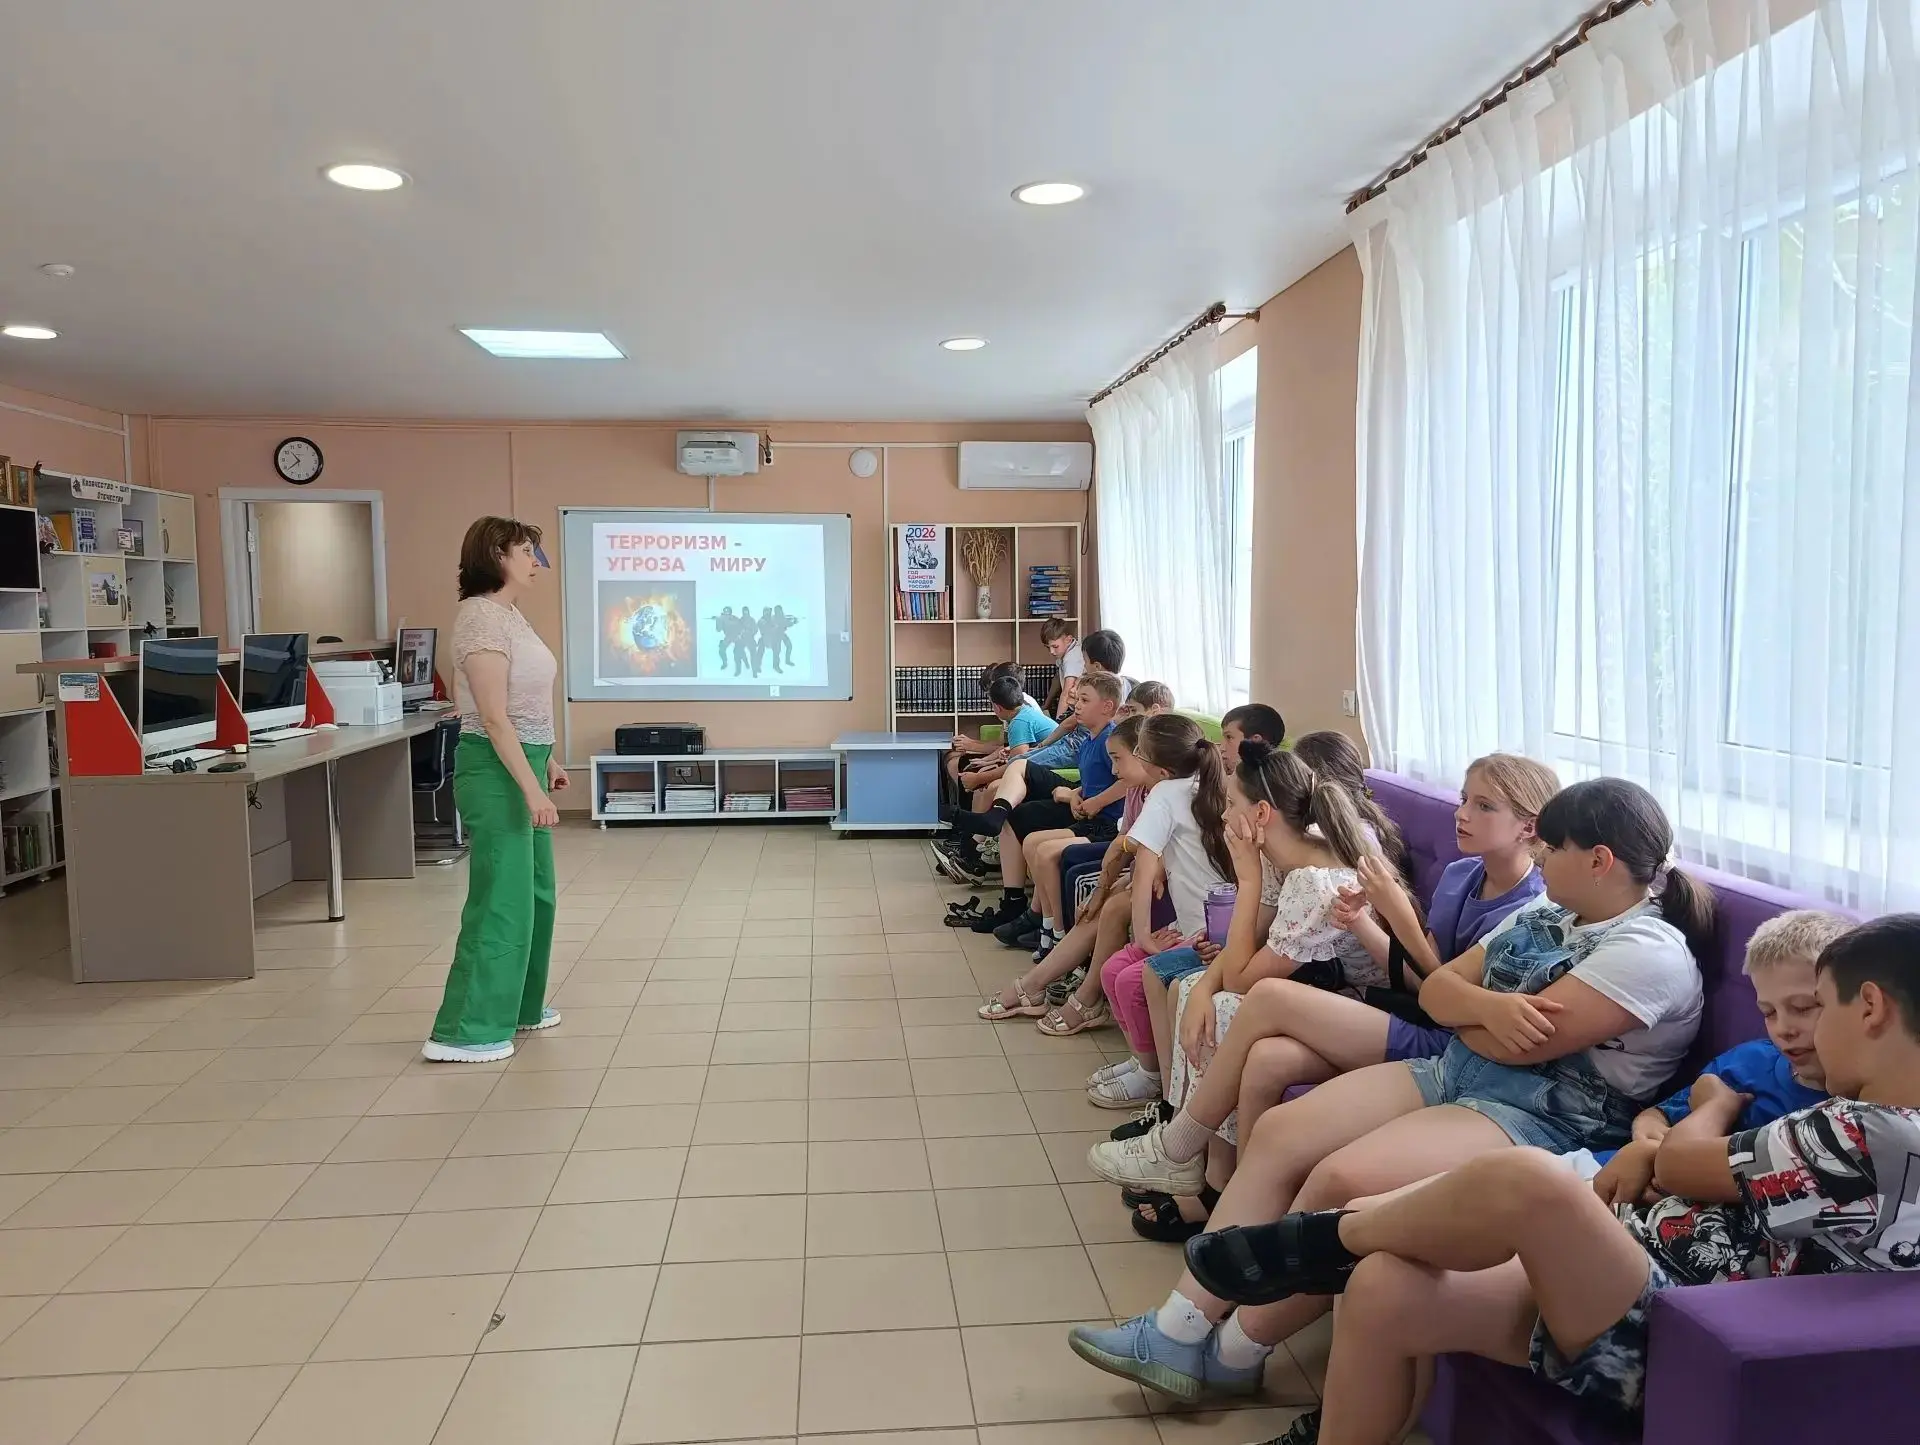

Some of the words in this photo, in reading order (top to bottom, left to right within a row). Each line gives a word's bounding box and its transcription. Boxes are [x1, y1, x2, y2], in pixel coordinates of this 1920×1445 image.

[907, 527, 936, 538] 2026
[606, 534, 727, 550] ТЕРРОРИЗМ
[607, 556, 686, 572] УГРОЗА
[710, 557, 767, 572] МИРУ
